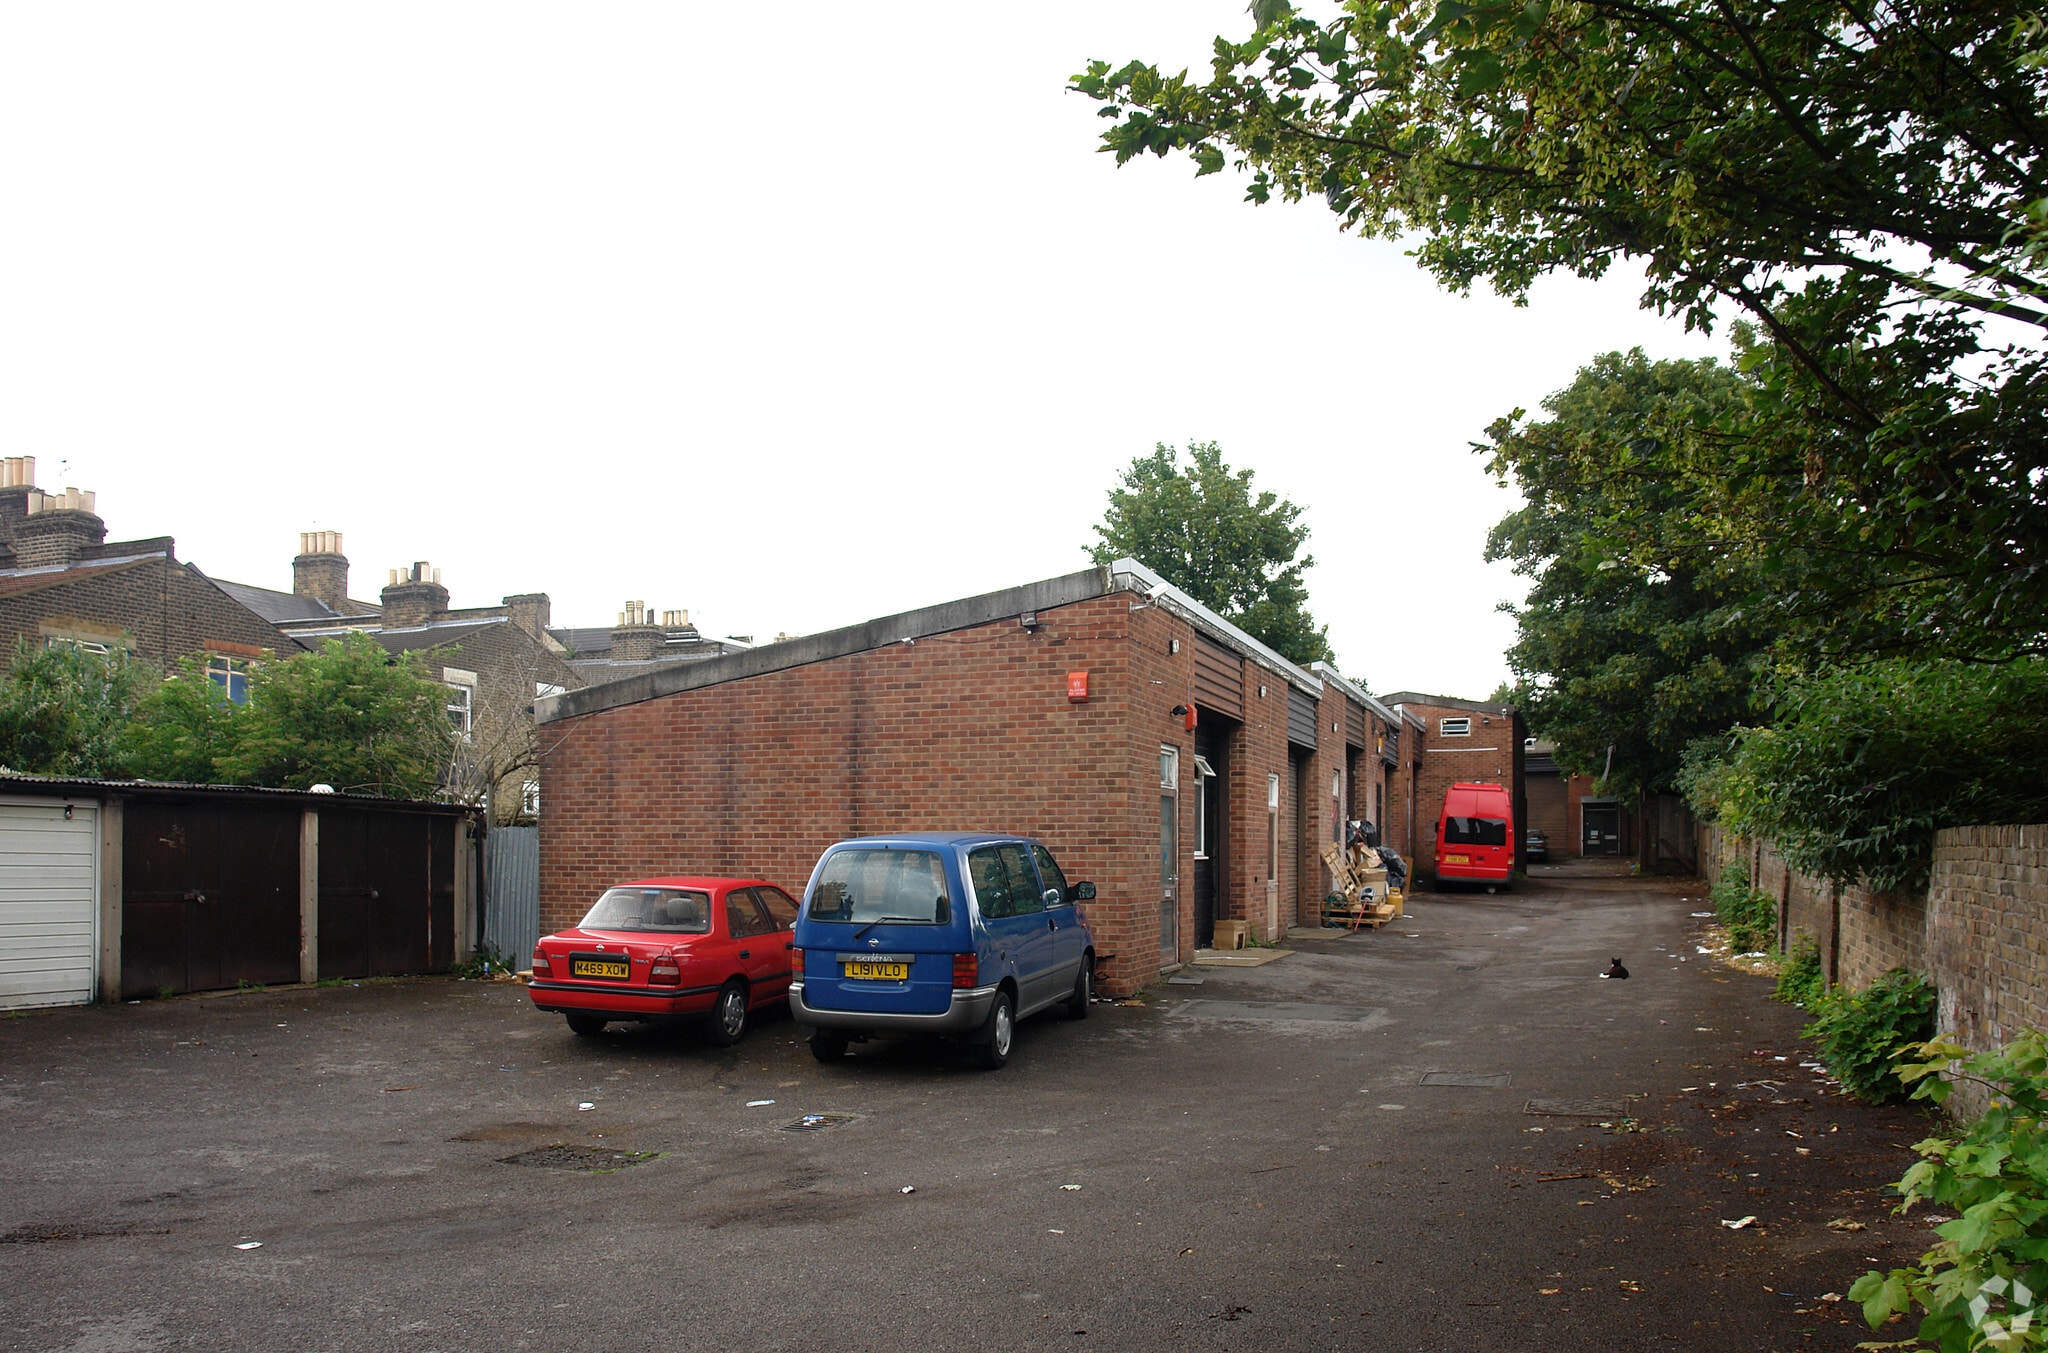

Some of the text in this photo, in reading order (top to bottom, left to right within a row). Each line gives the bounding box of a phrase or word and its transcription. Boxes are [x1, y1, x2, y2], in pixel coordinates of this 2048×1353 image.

[576, 962, 627, 976] M469 XOW
[851, 963, 901, 977] L191 VLO
